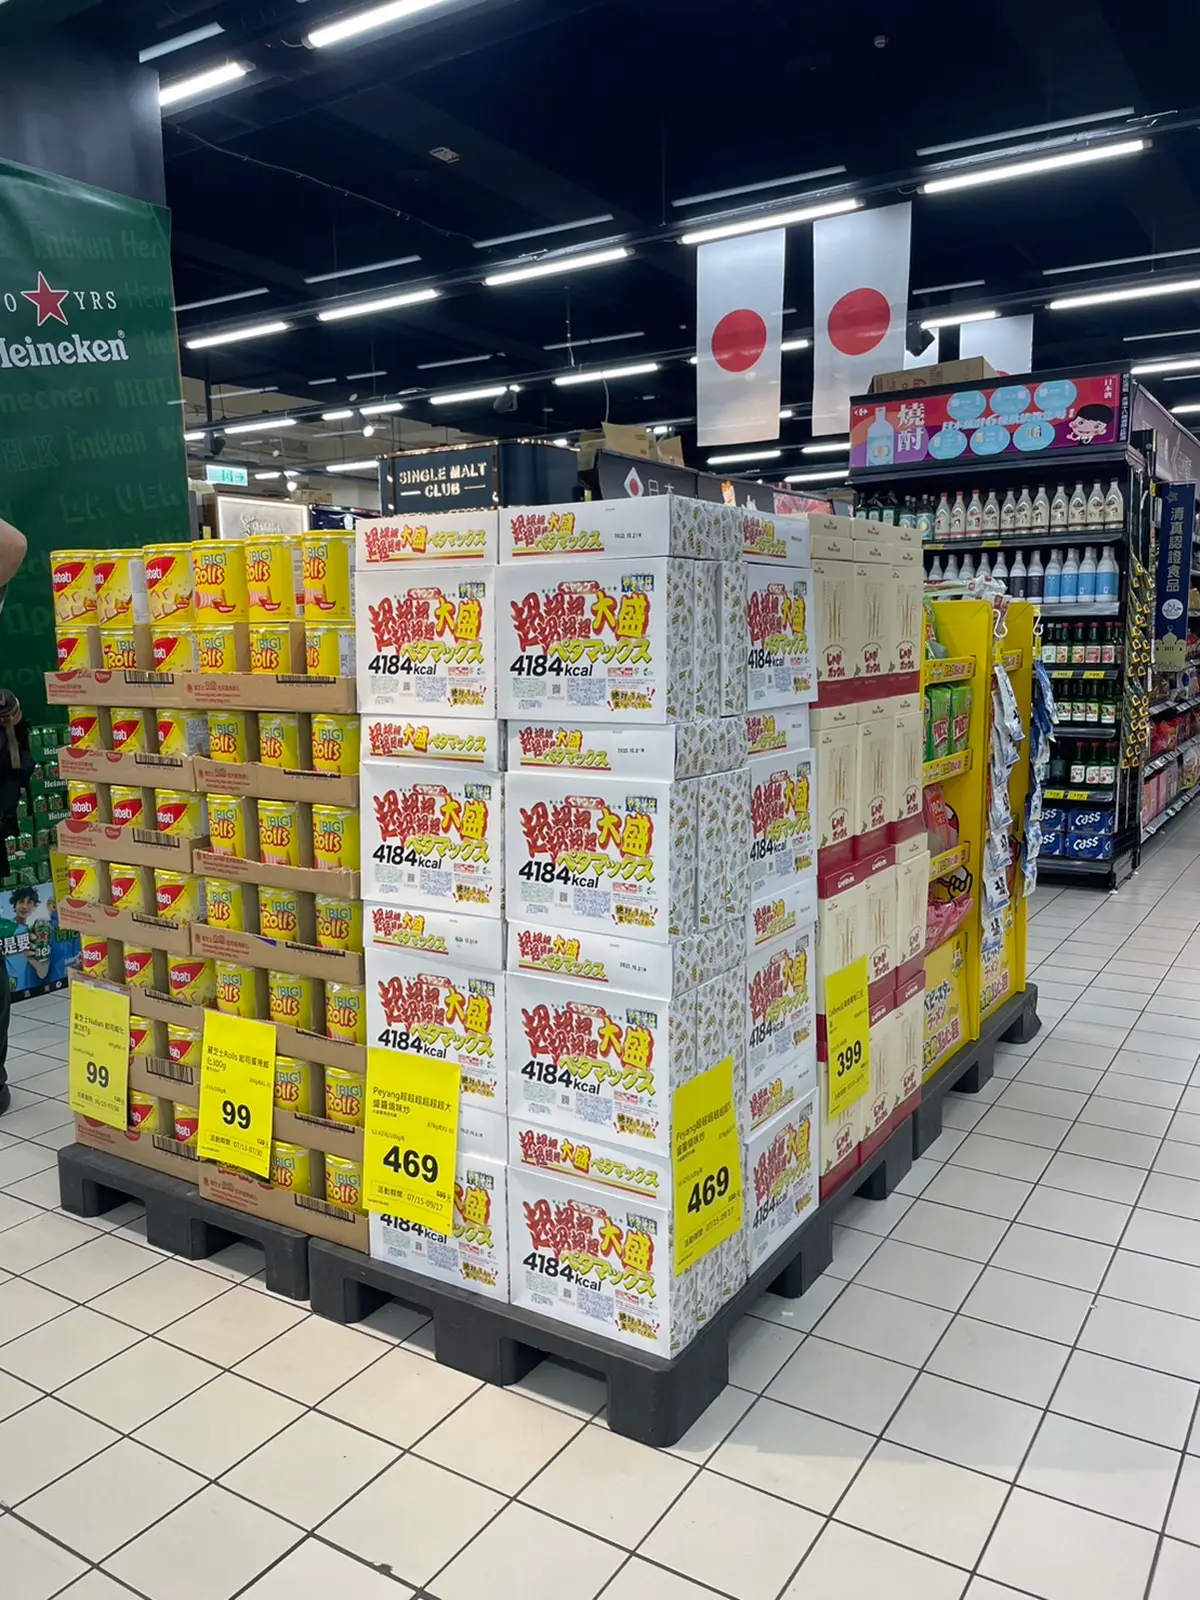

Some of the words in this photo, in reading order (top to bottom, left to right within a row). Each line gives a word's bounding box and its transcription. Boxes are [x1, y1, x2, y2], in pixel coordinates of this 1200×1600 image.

[73, 291, 117, 310] YRS
[399, 468, 446, 485] SINGLE
[449, 462, 487, 479] MALT
[425, 482, 461, 498] CLUB
[1166, 507, 1184, 592] 清真認證食品
[368, 654, 413, 675] 4184
[412, 663, 437, 676] kcal
[400, 641, 485, 664] ペタマックス
[549, 639, 652, 664] ペタマックス
[748, 650, 773, 669] 4184
[772, 655, 785, 668] kcal
[509, 655, 564, 677] 4184
[564, 664, 593, 677] kcal
[372, 844, 418, 866] 4184
[417, 855, 442, 869] kcal
[405, 836, 490, 863] ペタマックス
[750, 839, 774, 862] 4184
[773, 839, 787, 853] kcal
[518, 860, 572, 885] 4184
[571, 873, 600, 889] kcal
[556, 852, 655, 882] ペタマックス
[0, 932, 31, 956] 是要
[377, 1028, 424, 1053] 4184
[423, 1042, 447, 1059] kcal
[409, 1023, 494, 1057] ペタマックス
[750, 1022, 773, 1048] 4184
[772, 1015, 786, 1035] kcal
[837, 1039, 862, 1078] 399
[86, 1061, 110, 1088] 99
[521, 1060, 572, 1084] 4184
[573, 1076, 601, 1095] kcal
[558, 1055, 657, 1095] ペタマックス
[222, 1099, 251, 1130] 99
[209, 1134, 231, 1145] 活動期間
[382, 1145, 439, 1183] 469
[377, 1185, 403, 1199] 活動期間
[407, 1192, 443, 1212] 07/15-09/17
[687, 1165, 730, 1214] 469
[424, 1228, 447, 1245] kcal
[522, 1251, 574, 1281] 4184
[574, 1273, 602, 1292] kcal
[559, 1252, 657, 1298] ペタマックス
